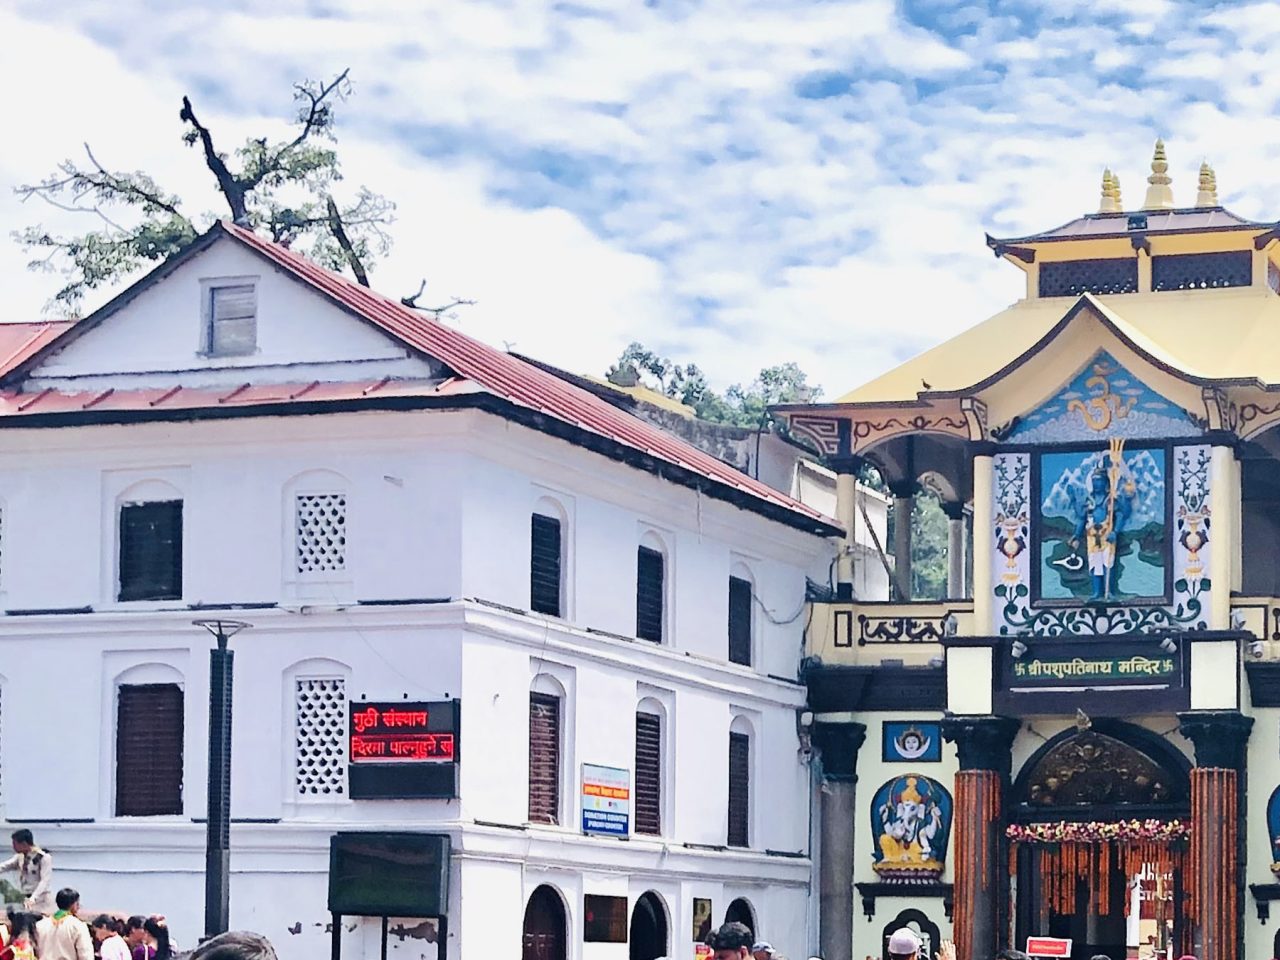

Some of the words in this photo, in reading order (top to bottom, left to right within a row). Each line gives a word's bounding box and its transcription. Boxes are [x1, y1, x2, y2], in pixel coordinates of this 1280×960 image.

[1118, 656, 1161, 674] मन्दिर
[353, 707, 379, 732] गुठी
[382, 709, 428, 727] संस्थान
